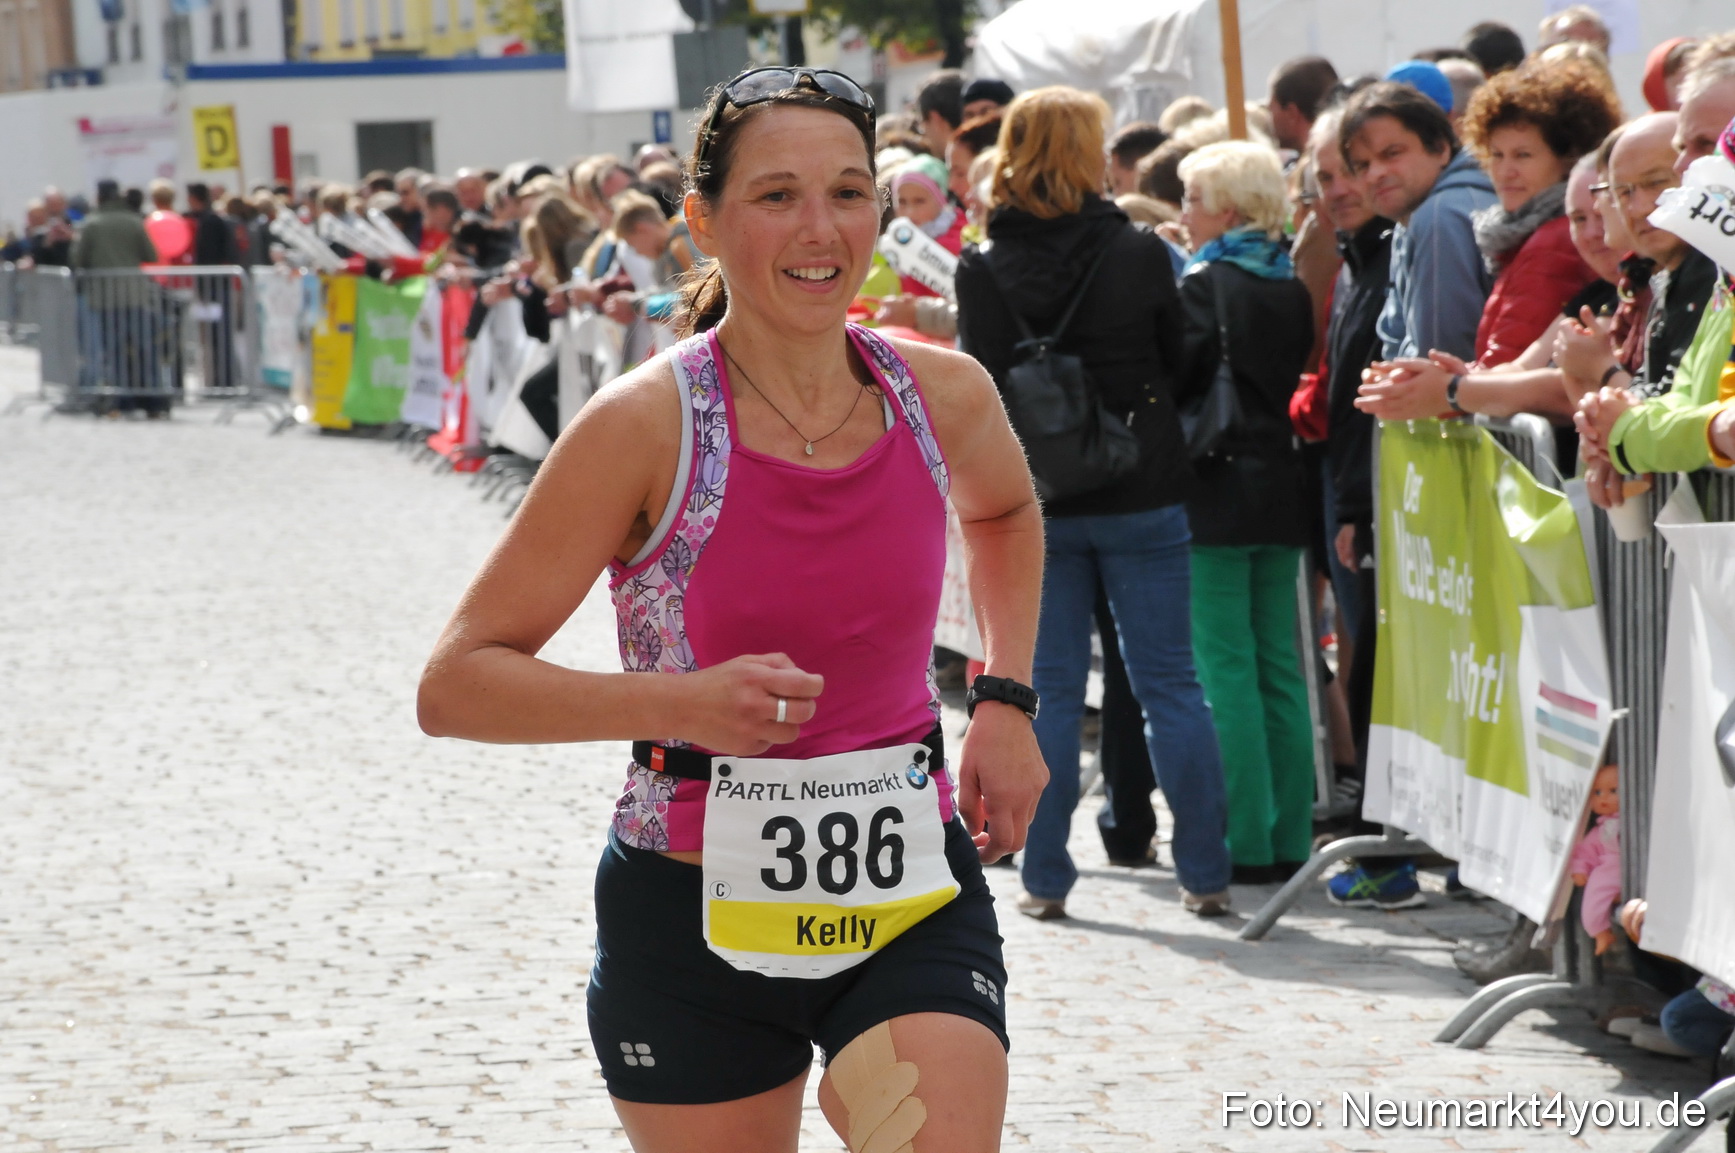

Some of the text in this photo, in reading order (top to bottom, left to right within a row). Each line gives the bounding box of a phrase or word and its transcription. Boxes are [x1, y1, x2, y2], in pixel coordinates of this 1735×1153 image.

[205, 124, 229, 157] D
[714, 772, 903, 801] PARTL Neumarkt
[760, 806, 905, 895] 386
[715, 883, 725, 898] C
[796, 914, 876, 950] Kelly
